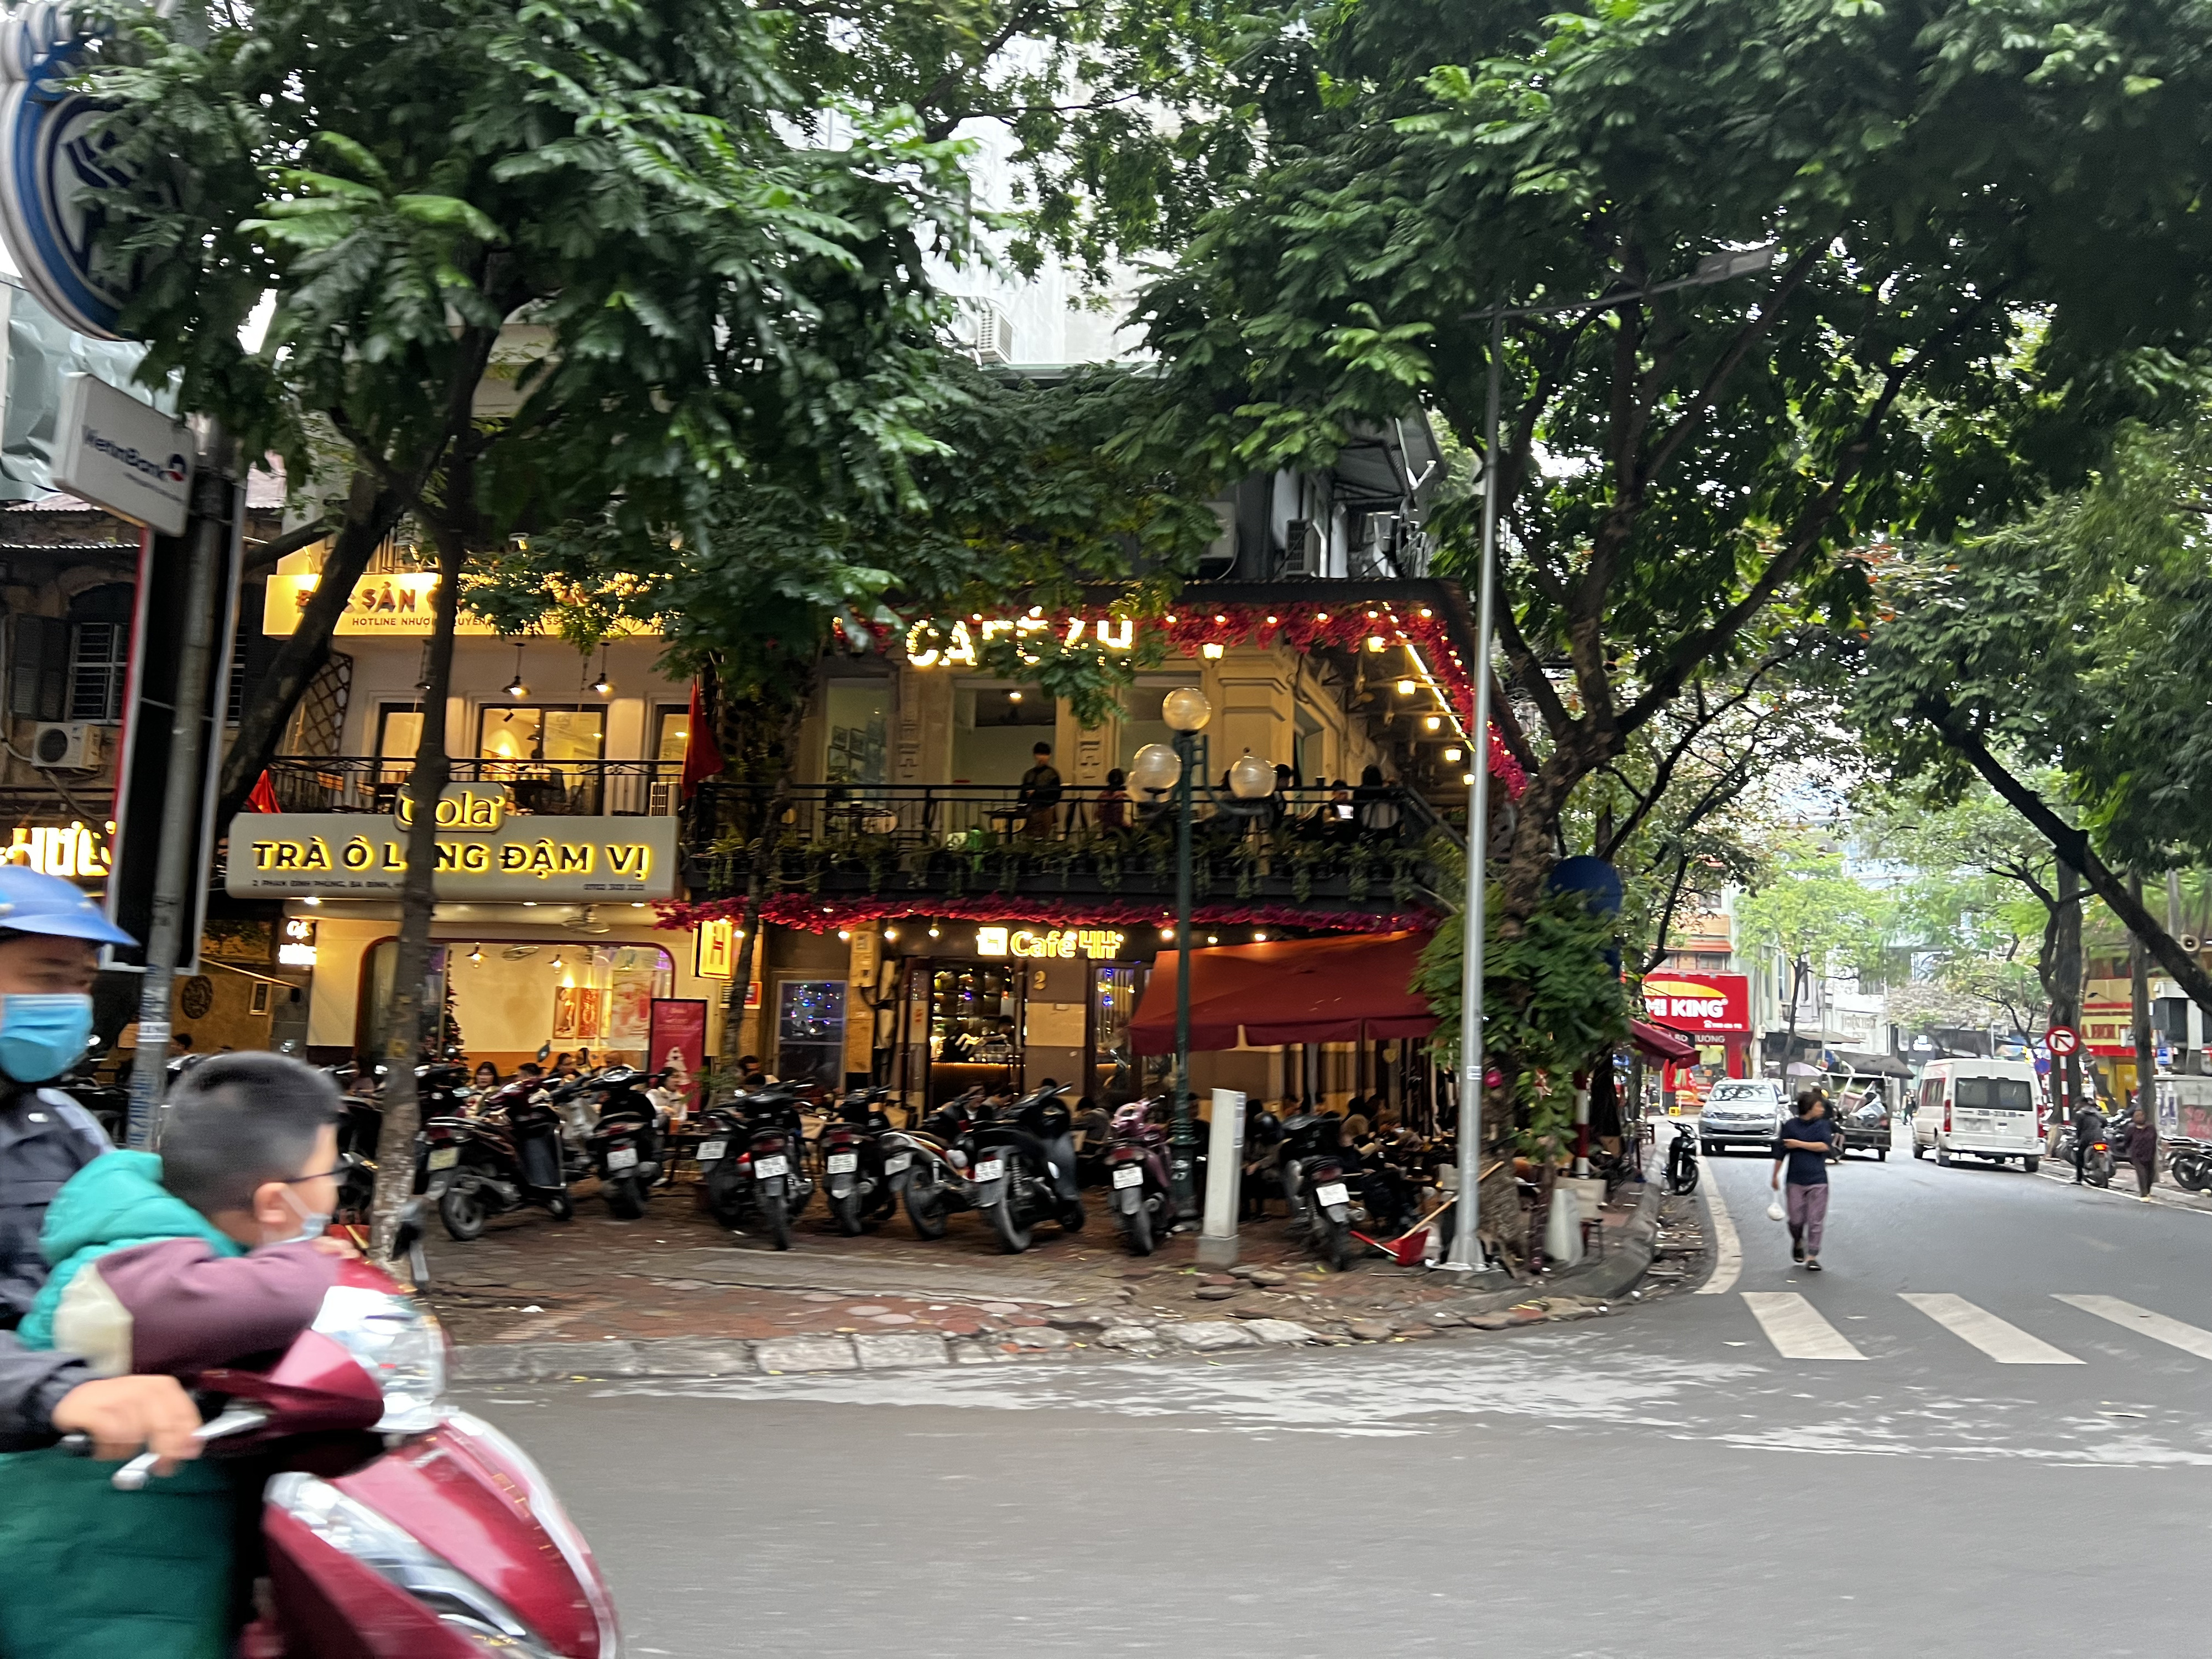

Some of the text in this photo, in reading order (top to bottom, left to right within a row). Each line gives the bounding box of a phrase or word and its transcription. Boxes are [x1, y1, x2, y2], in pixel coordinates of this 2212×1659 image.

[361, 581, 416, 612] SẢN
[352, 618, 397, 626] HOTLINE
[252, 834, 651, 881] TRÀ Ô LNG ĐẬM VỊ
[1010, 930, 1078, 958] Café
[1671, 998, 1724, 1019] KING
